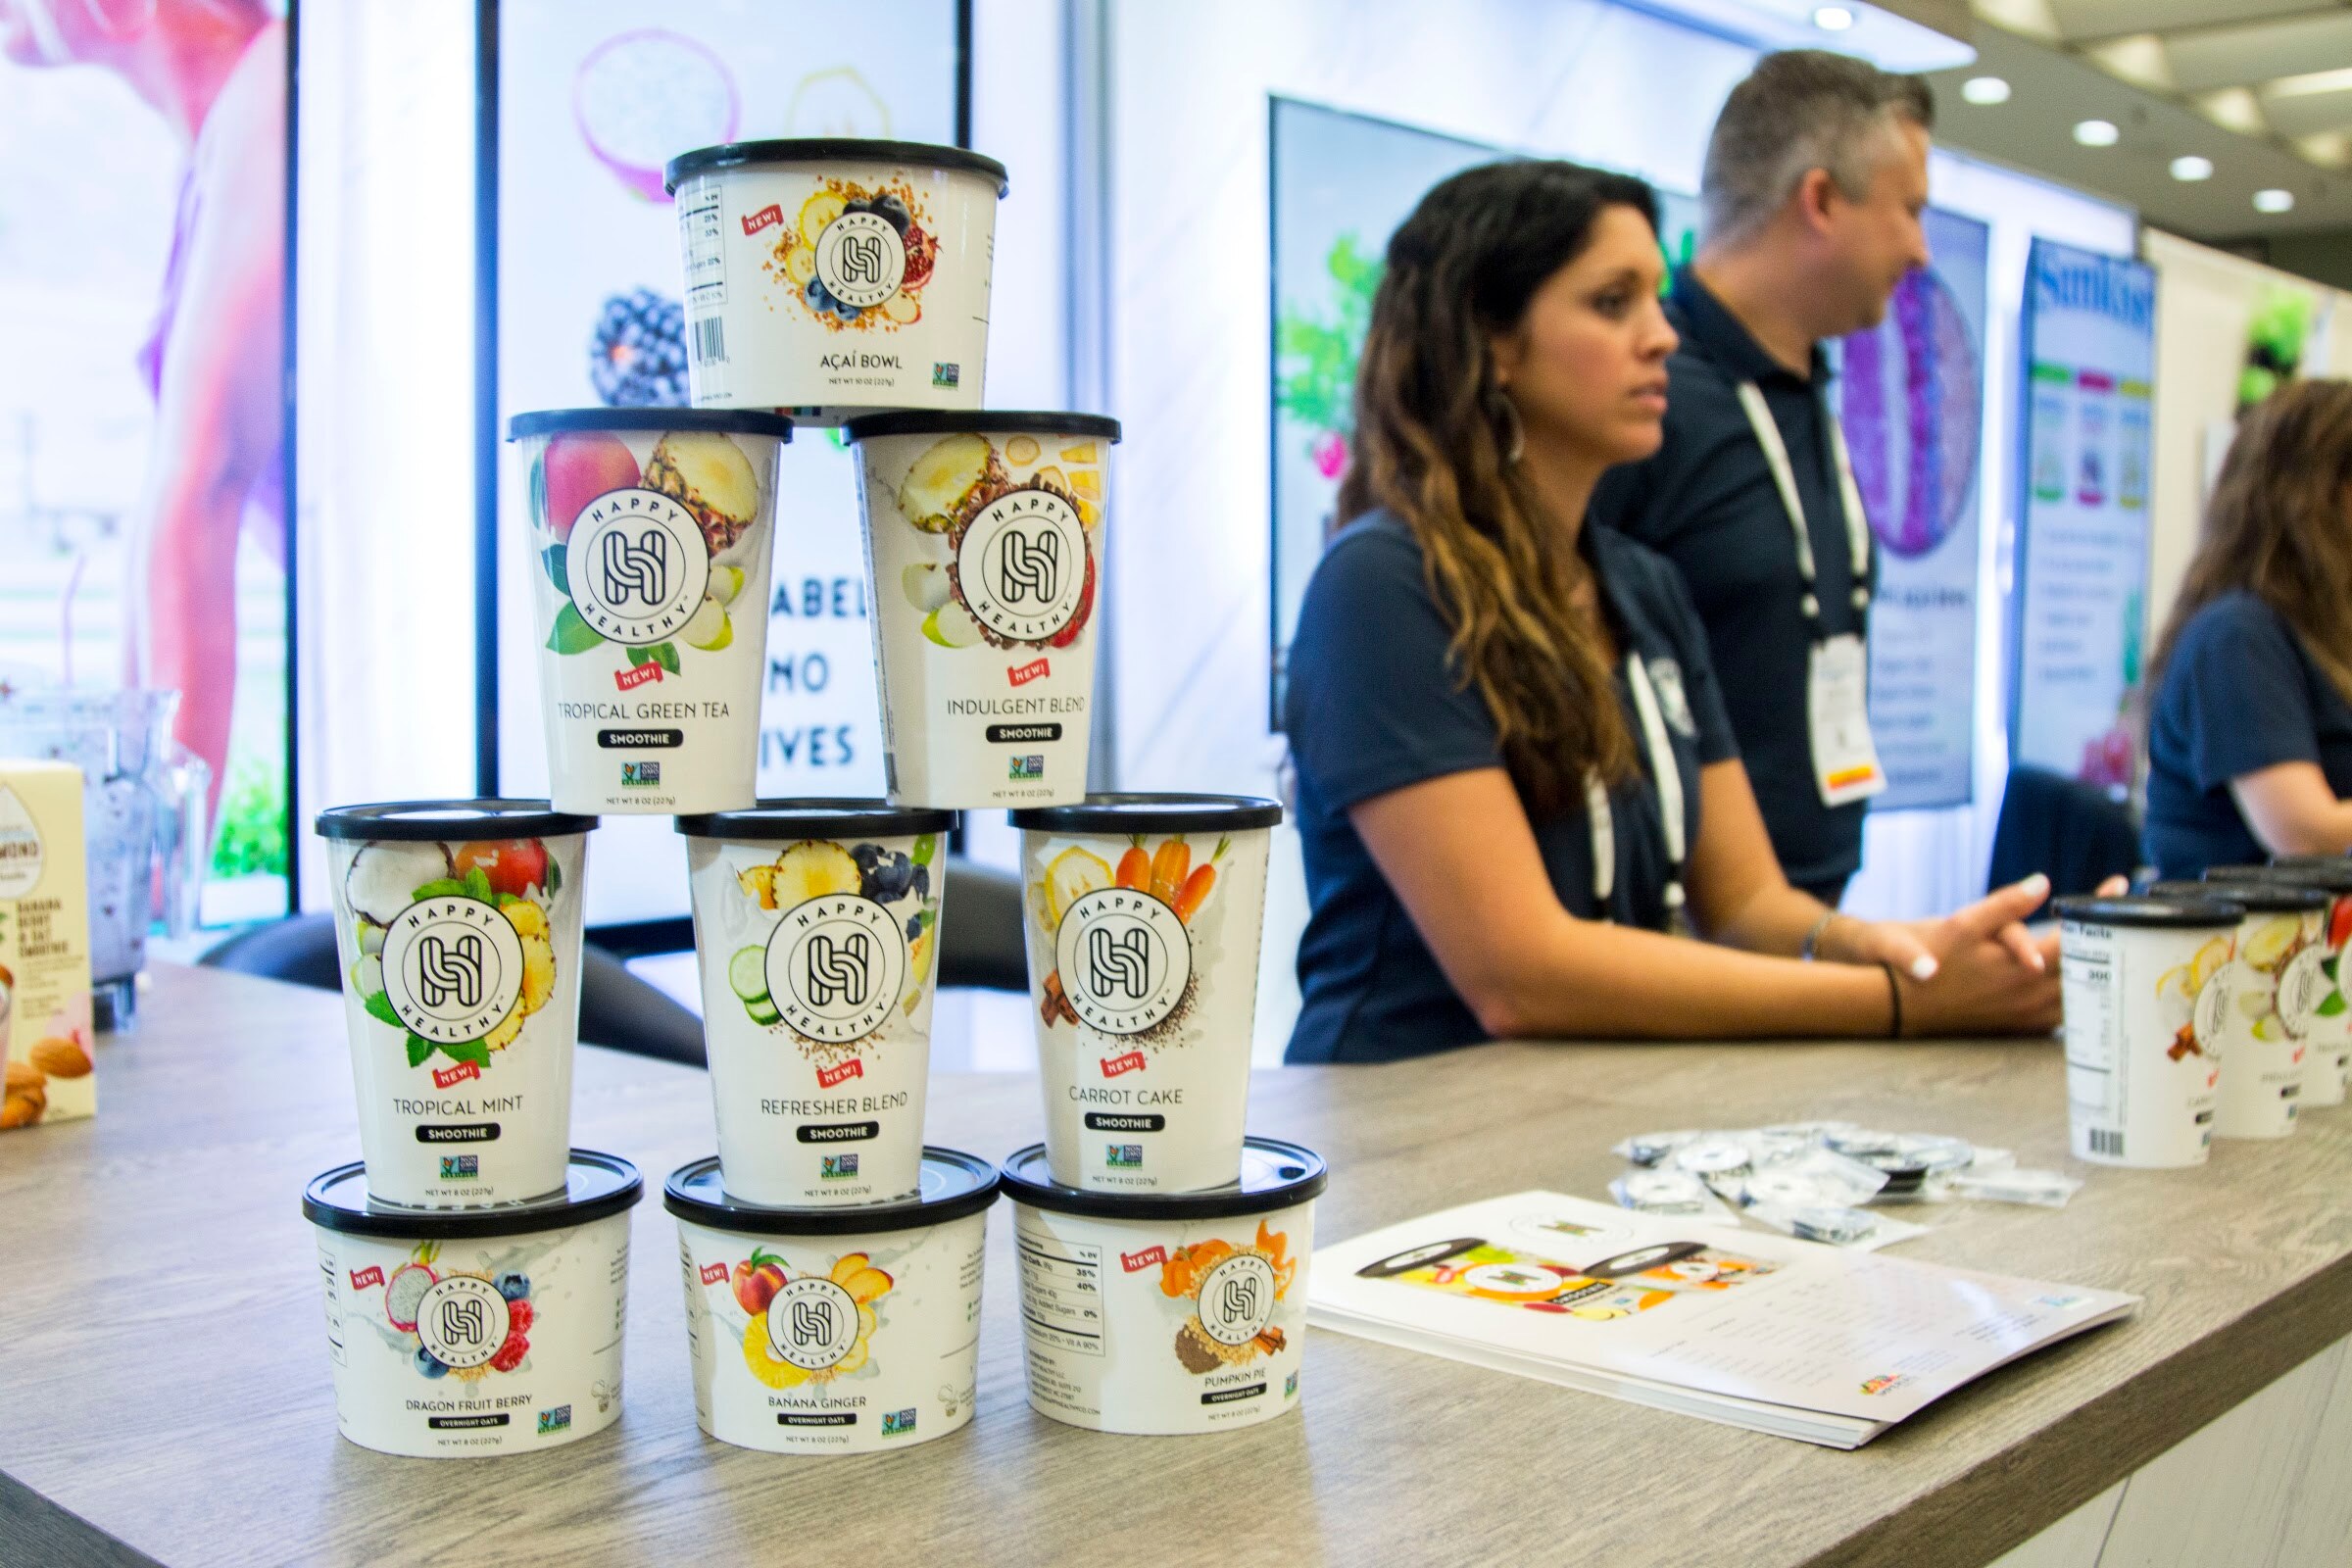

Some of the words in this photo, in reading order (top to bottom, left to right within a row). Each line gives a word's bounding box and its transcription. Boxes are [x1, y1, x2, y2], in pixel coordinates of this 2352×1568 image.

[748, 210, 777, 229] NEW!
[837, 217, 888, 231] HAPPY
[829, 281, 893, 303] HEALTHY
[820, 350, 857, 370] AÇAÍ
[861, 354, 903, 369] BOWL
[592, 498, 678, 522] HAPPY
[992, 499, 1068, 523] HAPPY
[584, 603, 687, 636] HEALTHY
[978, 601, 1070, 634] HEALTHY
[622, 667, 656, 686] NEW!
[769, 652, 829, 693] NO
[1015, 663, 1046, 681] NEW!
[558, 702, 630, 719] TROPICAL
[637, 702, 697, 719] GREEN
[703, 702, 730, 718] TEA
[948, 697, 1046, 715] INDULGENT
[1051, 697, 1084, 712] BLEND
[610, 733, 669, 745] SMOOTHIE
[999, 727, 1053, 739] SMOOTHIE
[408, 905, 494, 928] HAPPY
[797, 903, 880, 927] HAPPY
[1079, 898, 1160, 918] HAPPY
[401, 1003, 504, 1038] HEALTHY
[785, 1002, 885, 1037] HEALTHY
[1073, 994, 1169, 1028] HEALTHY
[440, 1065, 474, 1084] NEW!
[823, 1064, 857, 1084] NEW!
[1106, 1057, 1140, 1074] NEW!
[760, 1099, 858, 1116] REFRESHER
[862, 1091, 907, 1112] BLEND
[1069, 1085, 1131, 1105] CARROT
[1137, 1089, 1184, 1105] CAKE
[393, 1098, 476, 1115] TROPICAL
[482, 1095, 523, 1113] MINT
[1095, 1117, 1152, 1129] SMOOTHIE
[427, 1128, 487, 1140] SMOOTHIE
[809, 1127, 868, 1140] SMOOTHIE
[1128, 1251, 1160, 1267] NEW!
[1220, 1259, 1263, 1277] HAPPY
[355, 1271, 379, 1286] NEW!
[704, 1267, 724, 1281] NEW!
[435, 1281, 489, 1297] HAPPY
[786, 1282, 839, 1298] HAPPY
[1209, 1316, 1264, 1341] HEALTHY
[431, 1342, 497, 1364] HEALTHY
[780, 1343, 846, 1366] HEALTHY
[1204, 1373, 1251, 1389] PUMPKIN
[1253, 1368, 1266, 1379] PIE
[406, 1399, 455, 1412] DRAGON
[459, 1398, 492, 1411] FRUIT
[497, 1394, 533, 1408] BERRY
[768, 1396, 817, 1409] BANANA
[820, 1396, 866, 1409] GINGER
[1211, 1392, 1246, 1402] OVERNIGHT
[1246, 1388, 1259, 1397] OATS
[440, 1418, 480, 1428] OVERNIGHT
[481, 1417, 498, 1426] OATS
[788, 1416, 826, 1425] OVERNIGHT
